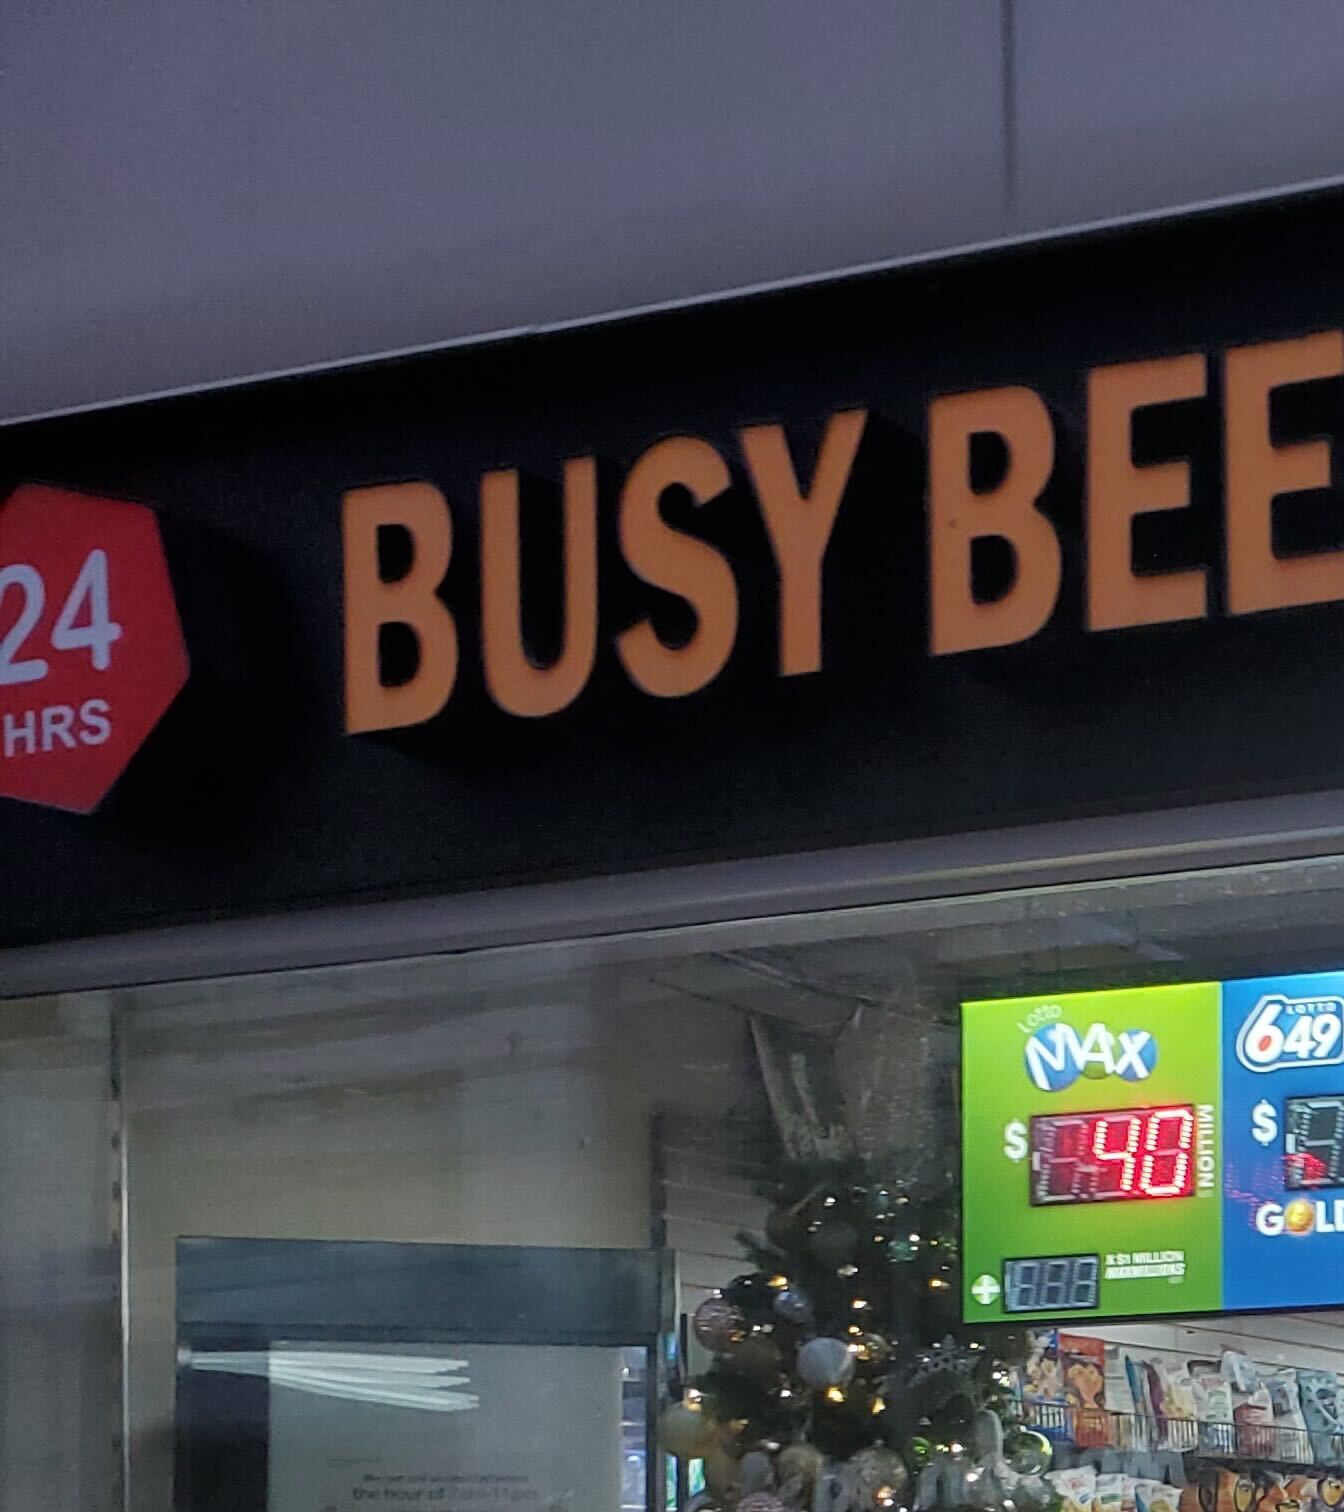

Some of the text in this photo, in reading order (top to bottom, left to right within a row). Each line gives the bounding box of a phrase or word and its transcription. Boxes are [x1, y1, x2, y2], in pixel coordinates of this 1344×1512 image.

[341, 408, 868, 735] BUSY
[0, 549, 122, 685] 24
[4, 699, 112, 757] HRS
[1025, 1022, 1152, 1091] MAX
[1004, 1118, 1028, 1163] $
[1252, 1099, 1278, 1146] $
